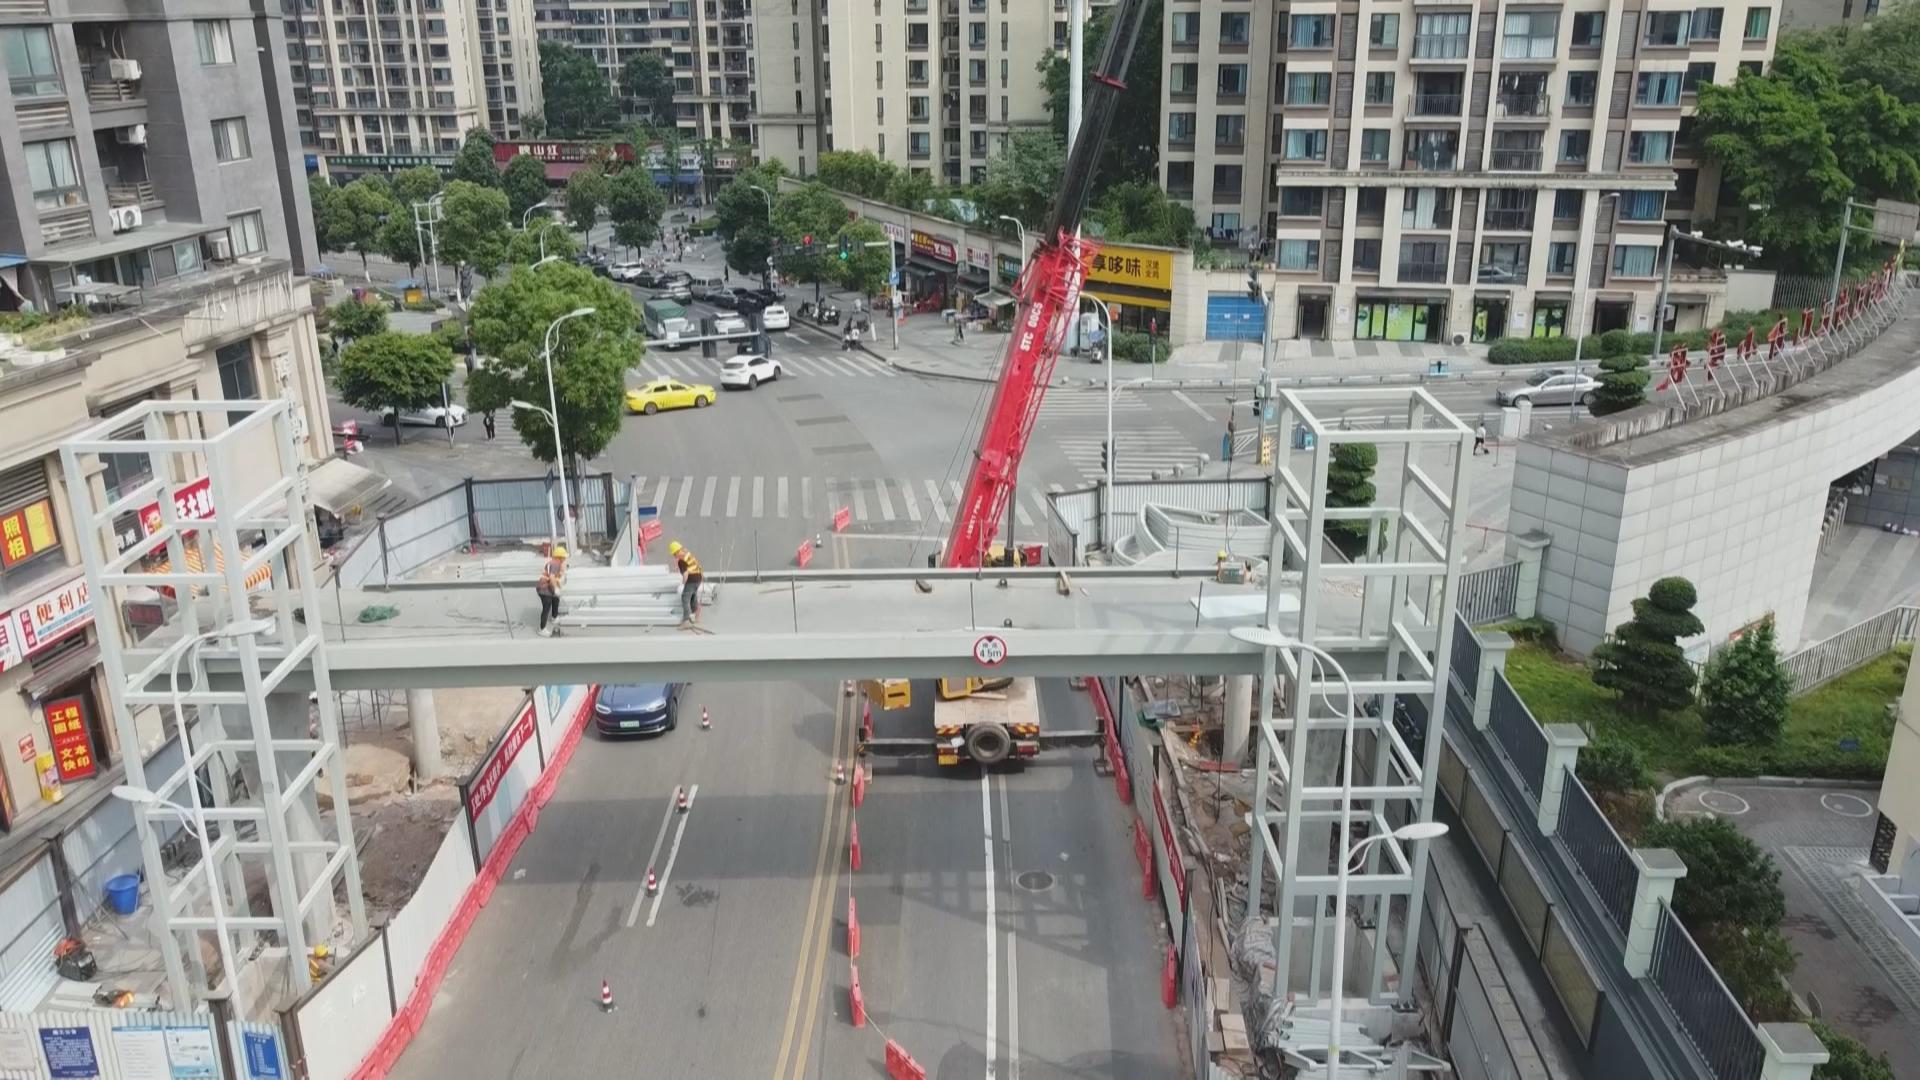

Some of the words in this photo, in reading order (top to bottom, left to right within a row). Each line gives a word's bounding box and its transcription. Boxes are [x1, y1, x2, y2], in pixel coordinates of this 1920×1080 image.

[1020, 331, 1034, 352] STC
[3, 515, 26, 560] 照相
[51, 706, 79, 722] 工程
[60, 745, 87, 760] 文本
[62, 756, 90, 772] 快印
